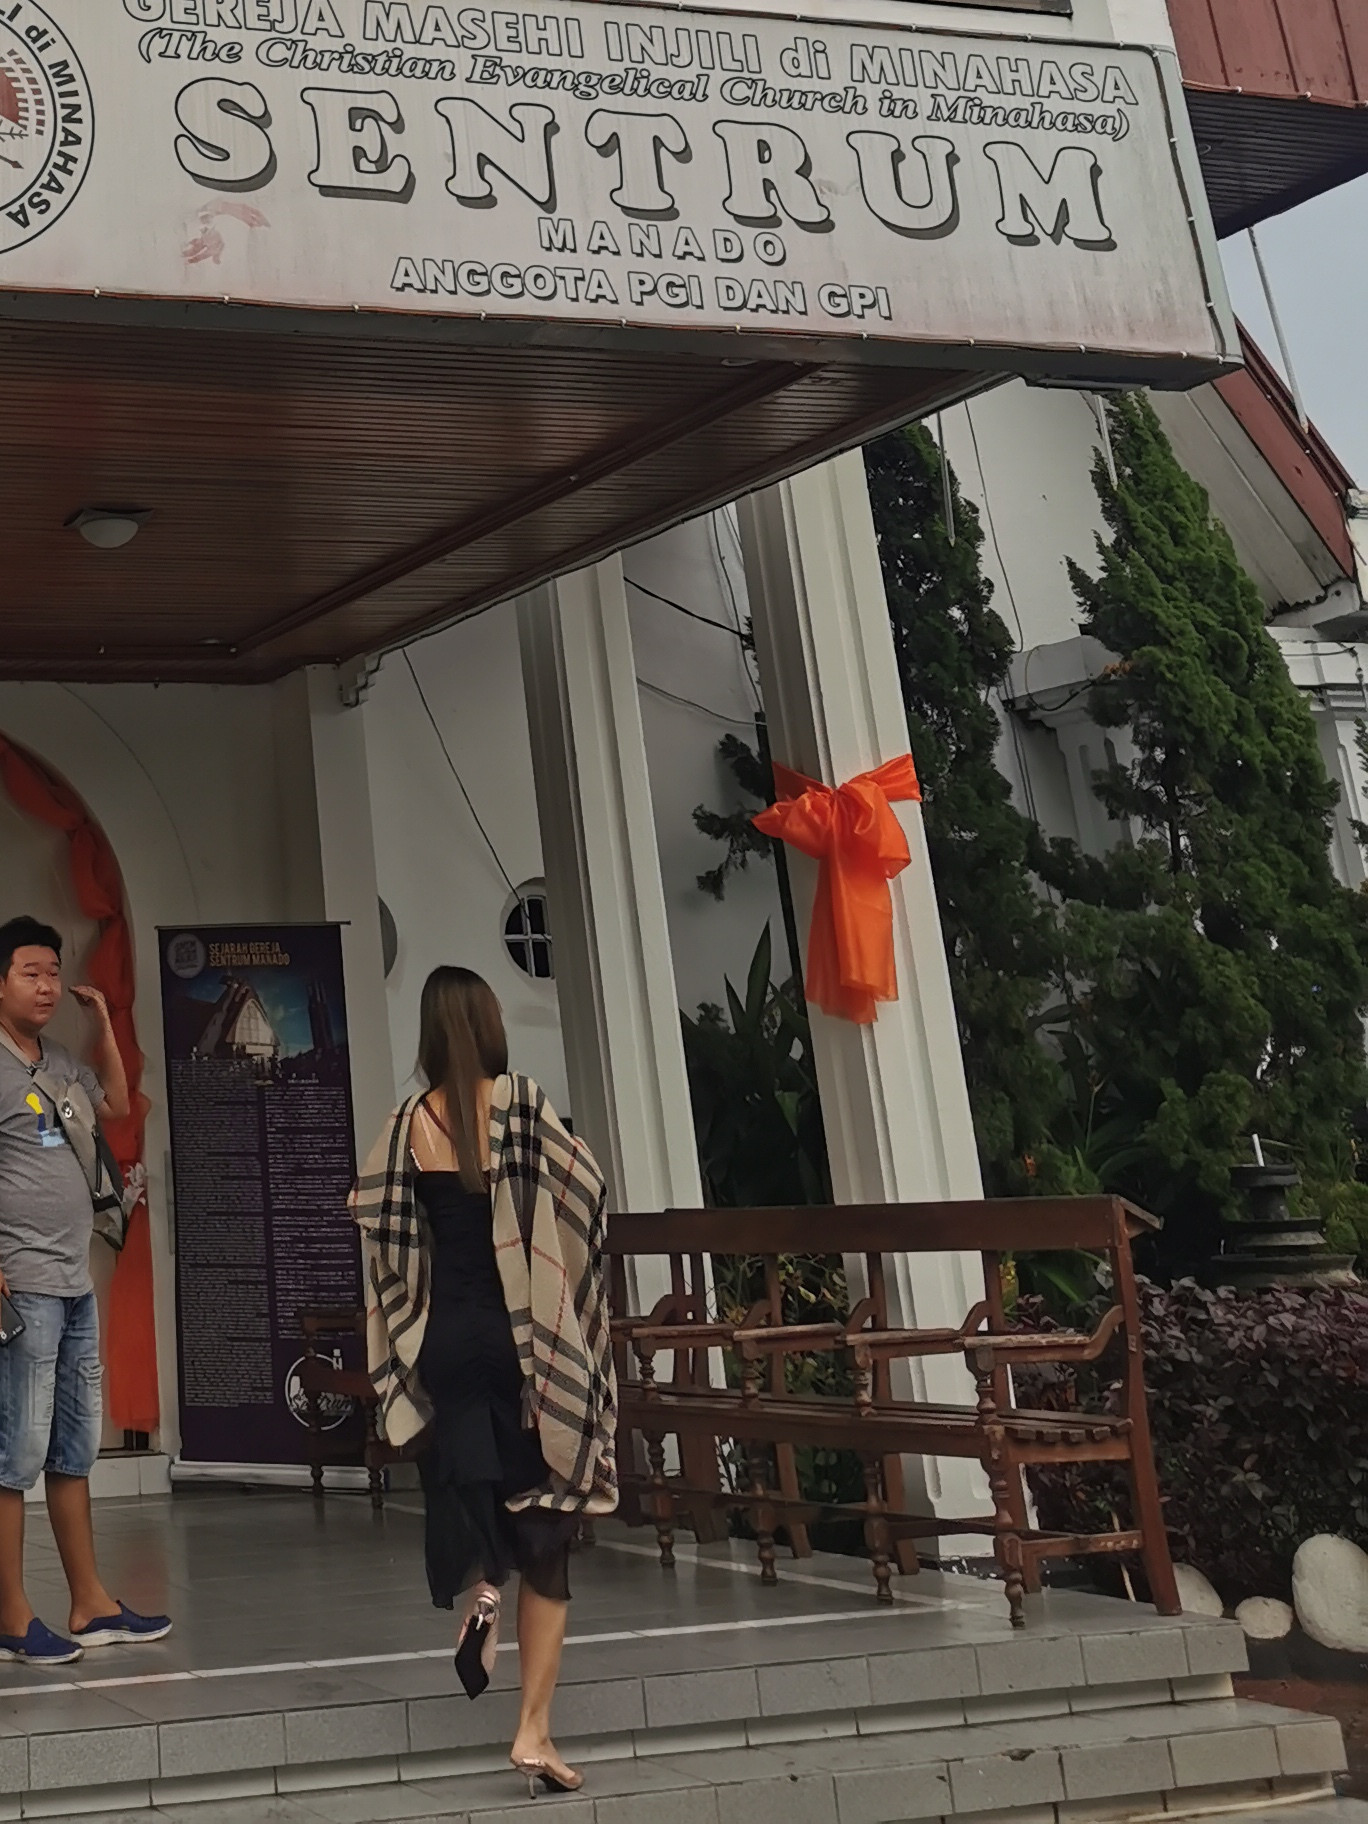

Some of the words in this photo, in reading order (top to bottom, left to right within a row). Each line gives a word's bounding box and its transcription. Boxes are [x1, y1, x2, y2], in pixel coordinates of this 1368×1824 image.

[25, 23, 56, 53] di
[362, 0, 584, 59] MASEHI
[604, 21, 761, 74] INJILI
[780, 36, 830, 80] di
[849, 44, 1138, 106] MINAHASA
[138, 27, 243, 64] (The
[255, 42, 456, 82] Christian
[466, 54, 709, 104] Evangelical
[720, 78, 869, 116] Church
[878, 90, 919, 120] in
[928, 95, 1130, 142] Minahasa)
[5, 58, 83, 230] MINAHASA
[174, 77, 1117, 251] SENTRUM
[539, 217, 786, 266] MANADO
[390, 256, 618, 306] ANGGOTA
[628, 271, 703, 311] PGI
[716, 274, 807, 316] DAN
[818, 283, 892, 321] GPI
[208, 942, 248, 954] SEJARAH
[210, 953, 250, 966] SENTRUM
[252, 952, 290, 966] MANADO
